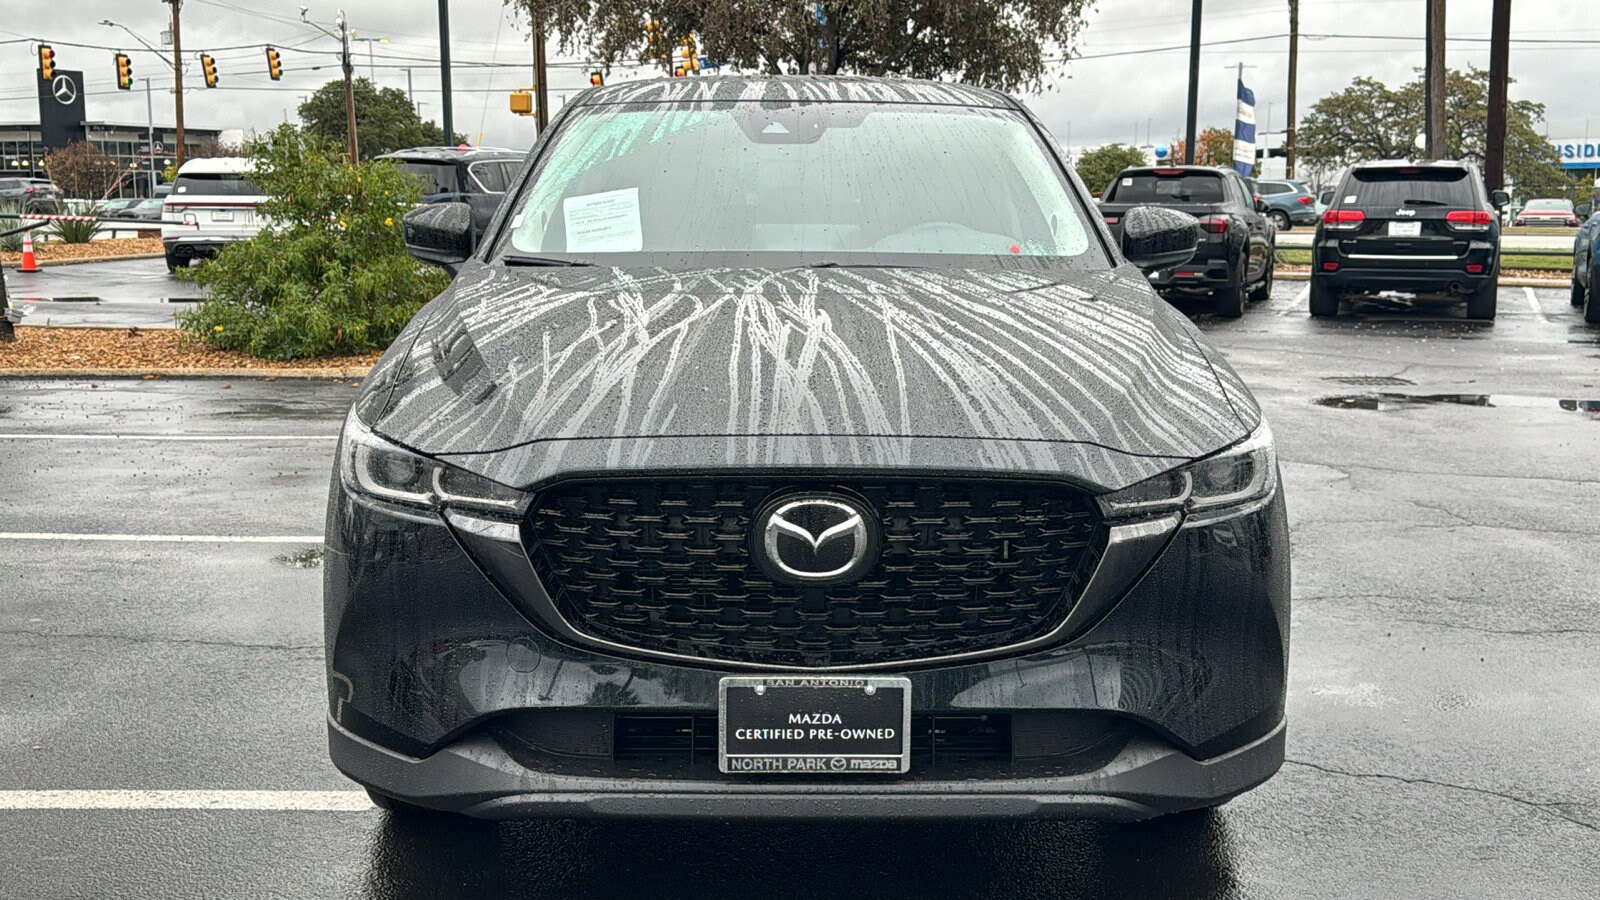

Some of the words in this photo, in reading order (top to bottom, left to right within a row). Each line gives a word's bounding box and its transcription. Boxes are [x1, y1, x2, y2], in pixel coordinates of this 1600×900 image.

[1395, 208, 1416, 217] Jeep
[788, 713, 842, 725] MAZDA
[735, 728, 805, 740] CERTIFIED
[809, 728, 895, 740] PRE-OWNED
[731, 758, 782, 770] NORTH
[787, 758, 827, 770] PARK
[850, 759, 897, 769] mazda
